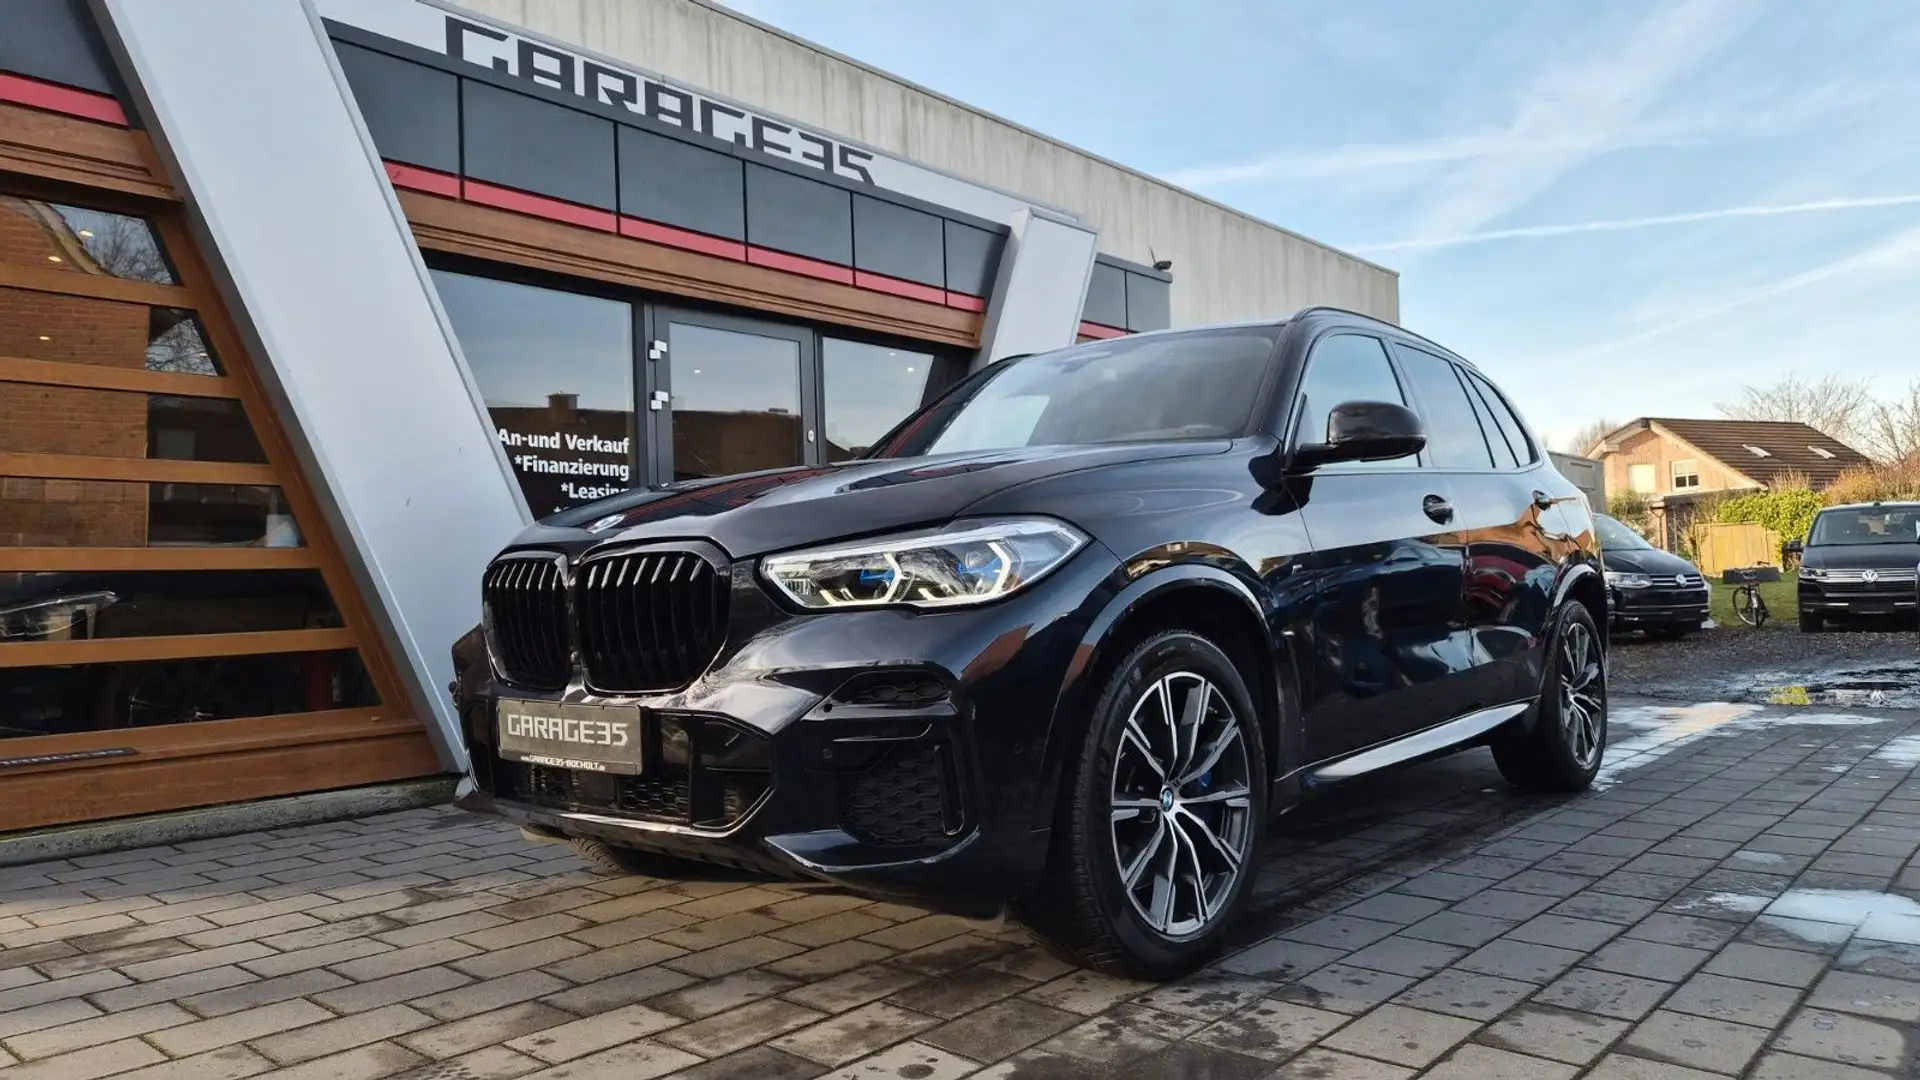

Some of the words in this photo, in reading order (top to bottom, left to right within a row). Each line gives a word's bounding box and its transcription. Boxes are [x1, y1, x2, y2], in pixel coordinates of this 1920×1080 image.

[445, 16, 875, 186] GARAGE35
[499, 428, 560, 449] An-und
[565, 433, 629, 454] Verkauf
[560, 482, 630, 499] Leasin
[507, 714, 628, 747] GARAGE35
